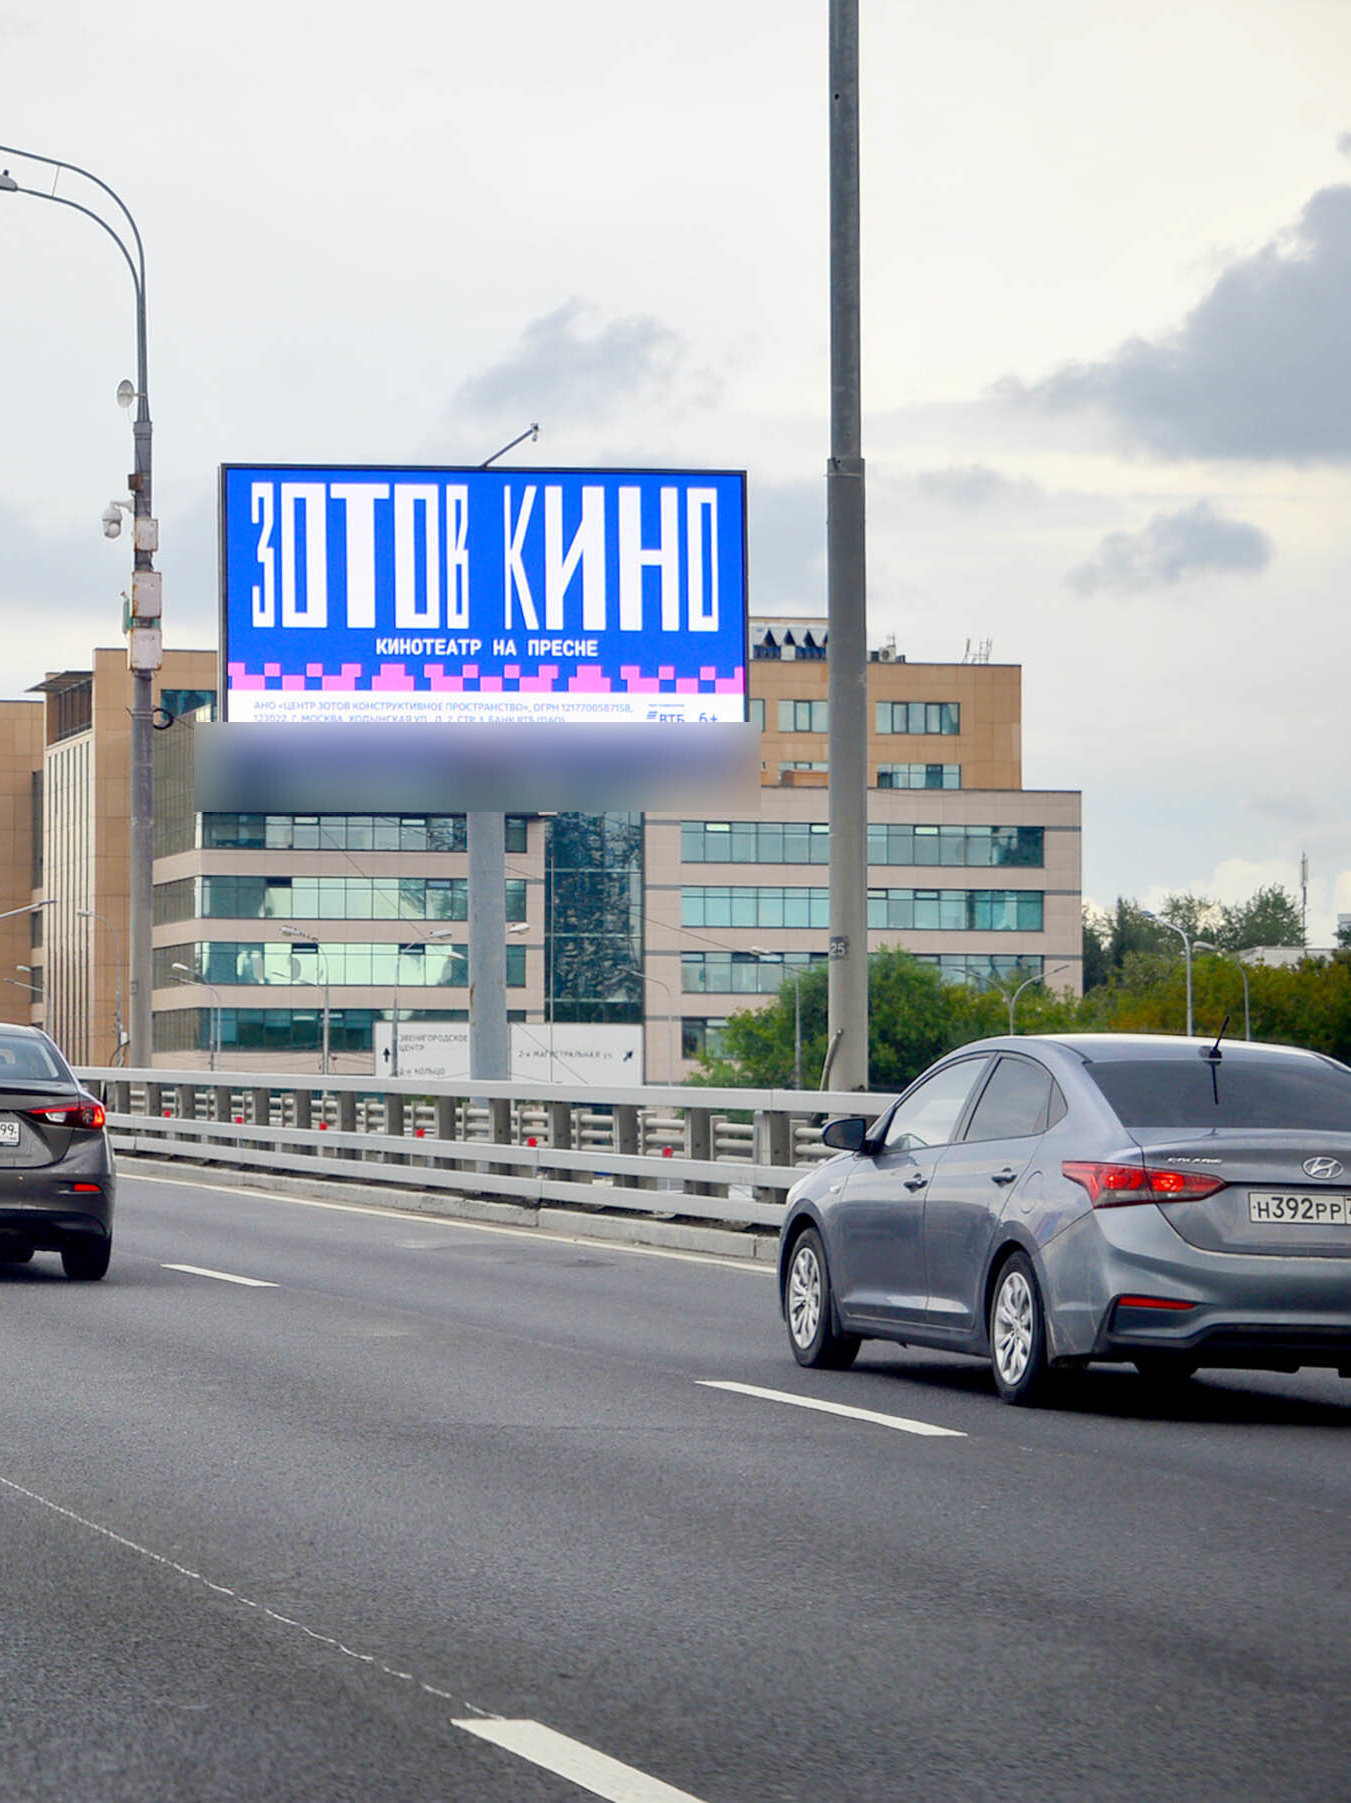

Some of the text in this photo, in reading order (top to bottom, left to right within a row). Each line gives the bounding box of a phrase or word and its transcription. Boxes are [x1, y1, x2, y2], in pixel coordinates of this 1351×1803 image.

[251, 482, 720, 632] ЗОТОВ КИНО
[376, 638, 599, 658] КИНОТЕАТР НА ПРЕСНЕ
[253, 701, 276, 710] АНО
[318, 702, 350, 711] ЗОТОВ
[352, 702, 442, 711] КОНСТРУКТИВНОЕ
[533, 703, 559, 712] ОГРН
[1257, 1196, 1342, 1220] Н392РР
